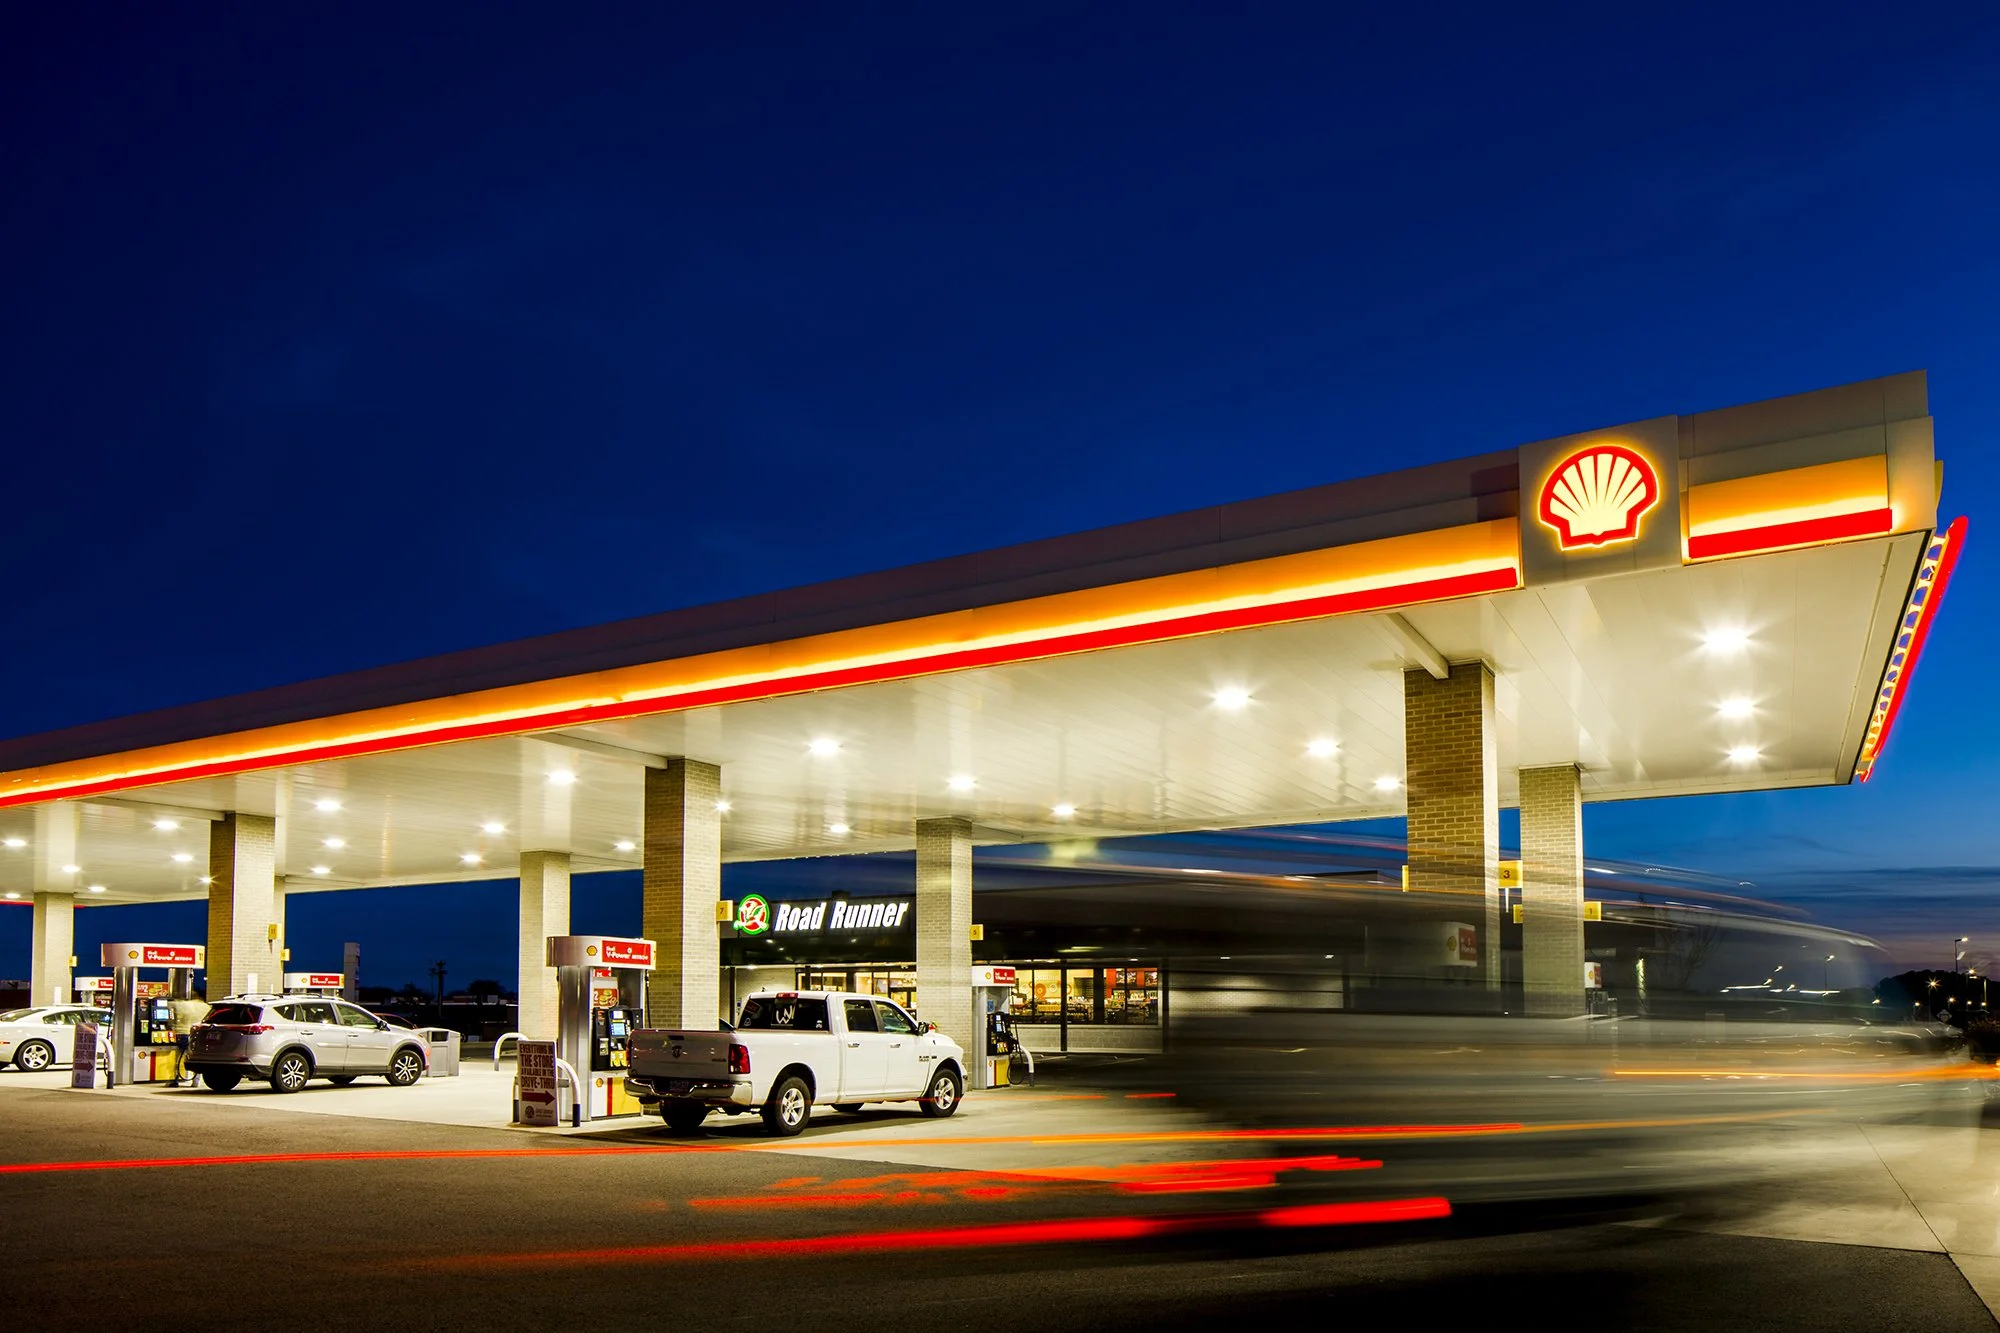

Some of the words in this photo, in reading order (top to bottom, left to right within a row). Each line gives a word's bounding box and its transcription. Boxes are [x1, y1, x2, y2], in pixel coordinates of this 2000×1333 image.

[1503, 870, 1510, 879] 3
[774, 902, 827, 932] Road
[830, 900, 910, 929] Runner
[520, 1044, 547, 1054] EVERYTHING
[520, 1054, 532, 1067] THE
[533, 1054, 554, 1068] STORE
[521, 1076, 554, 1089] DRIVE-THRU
